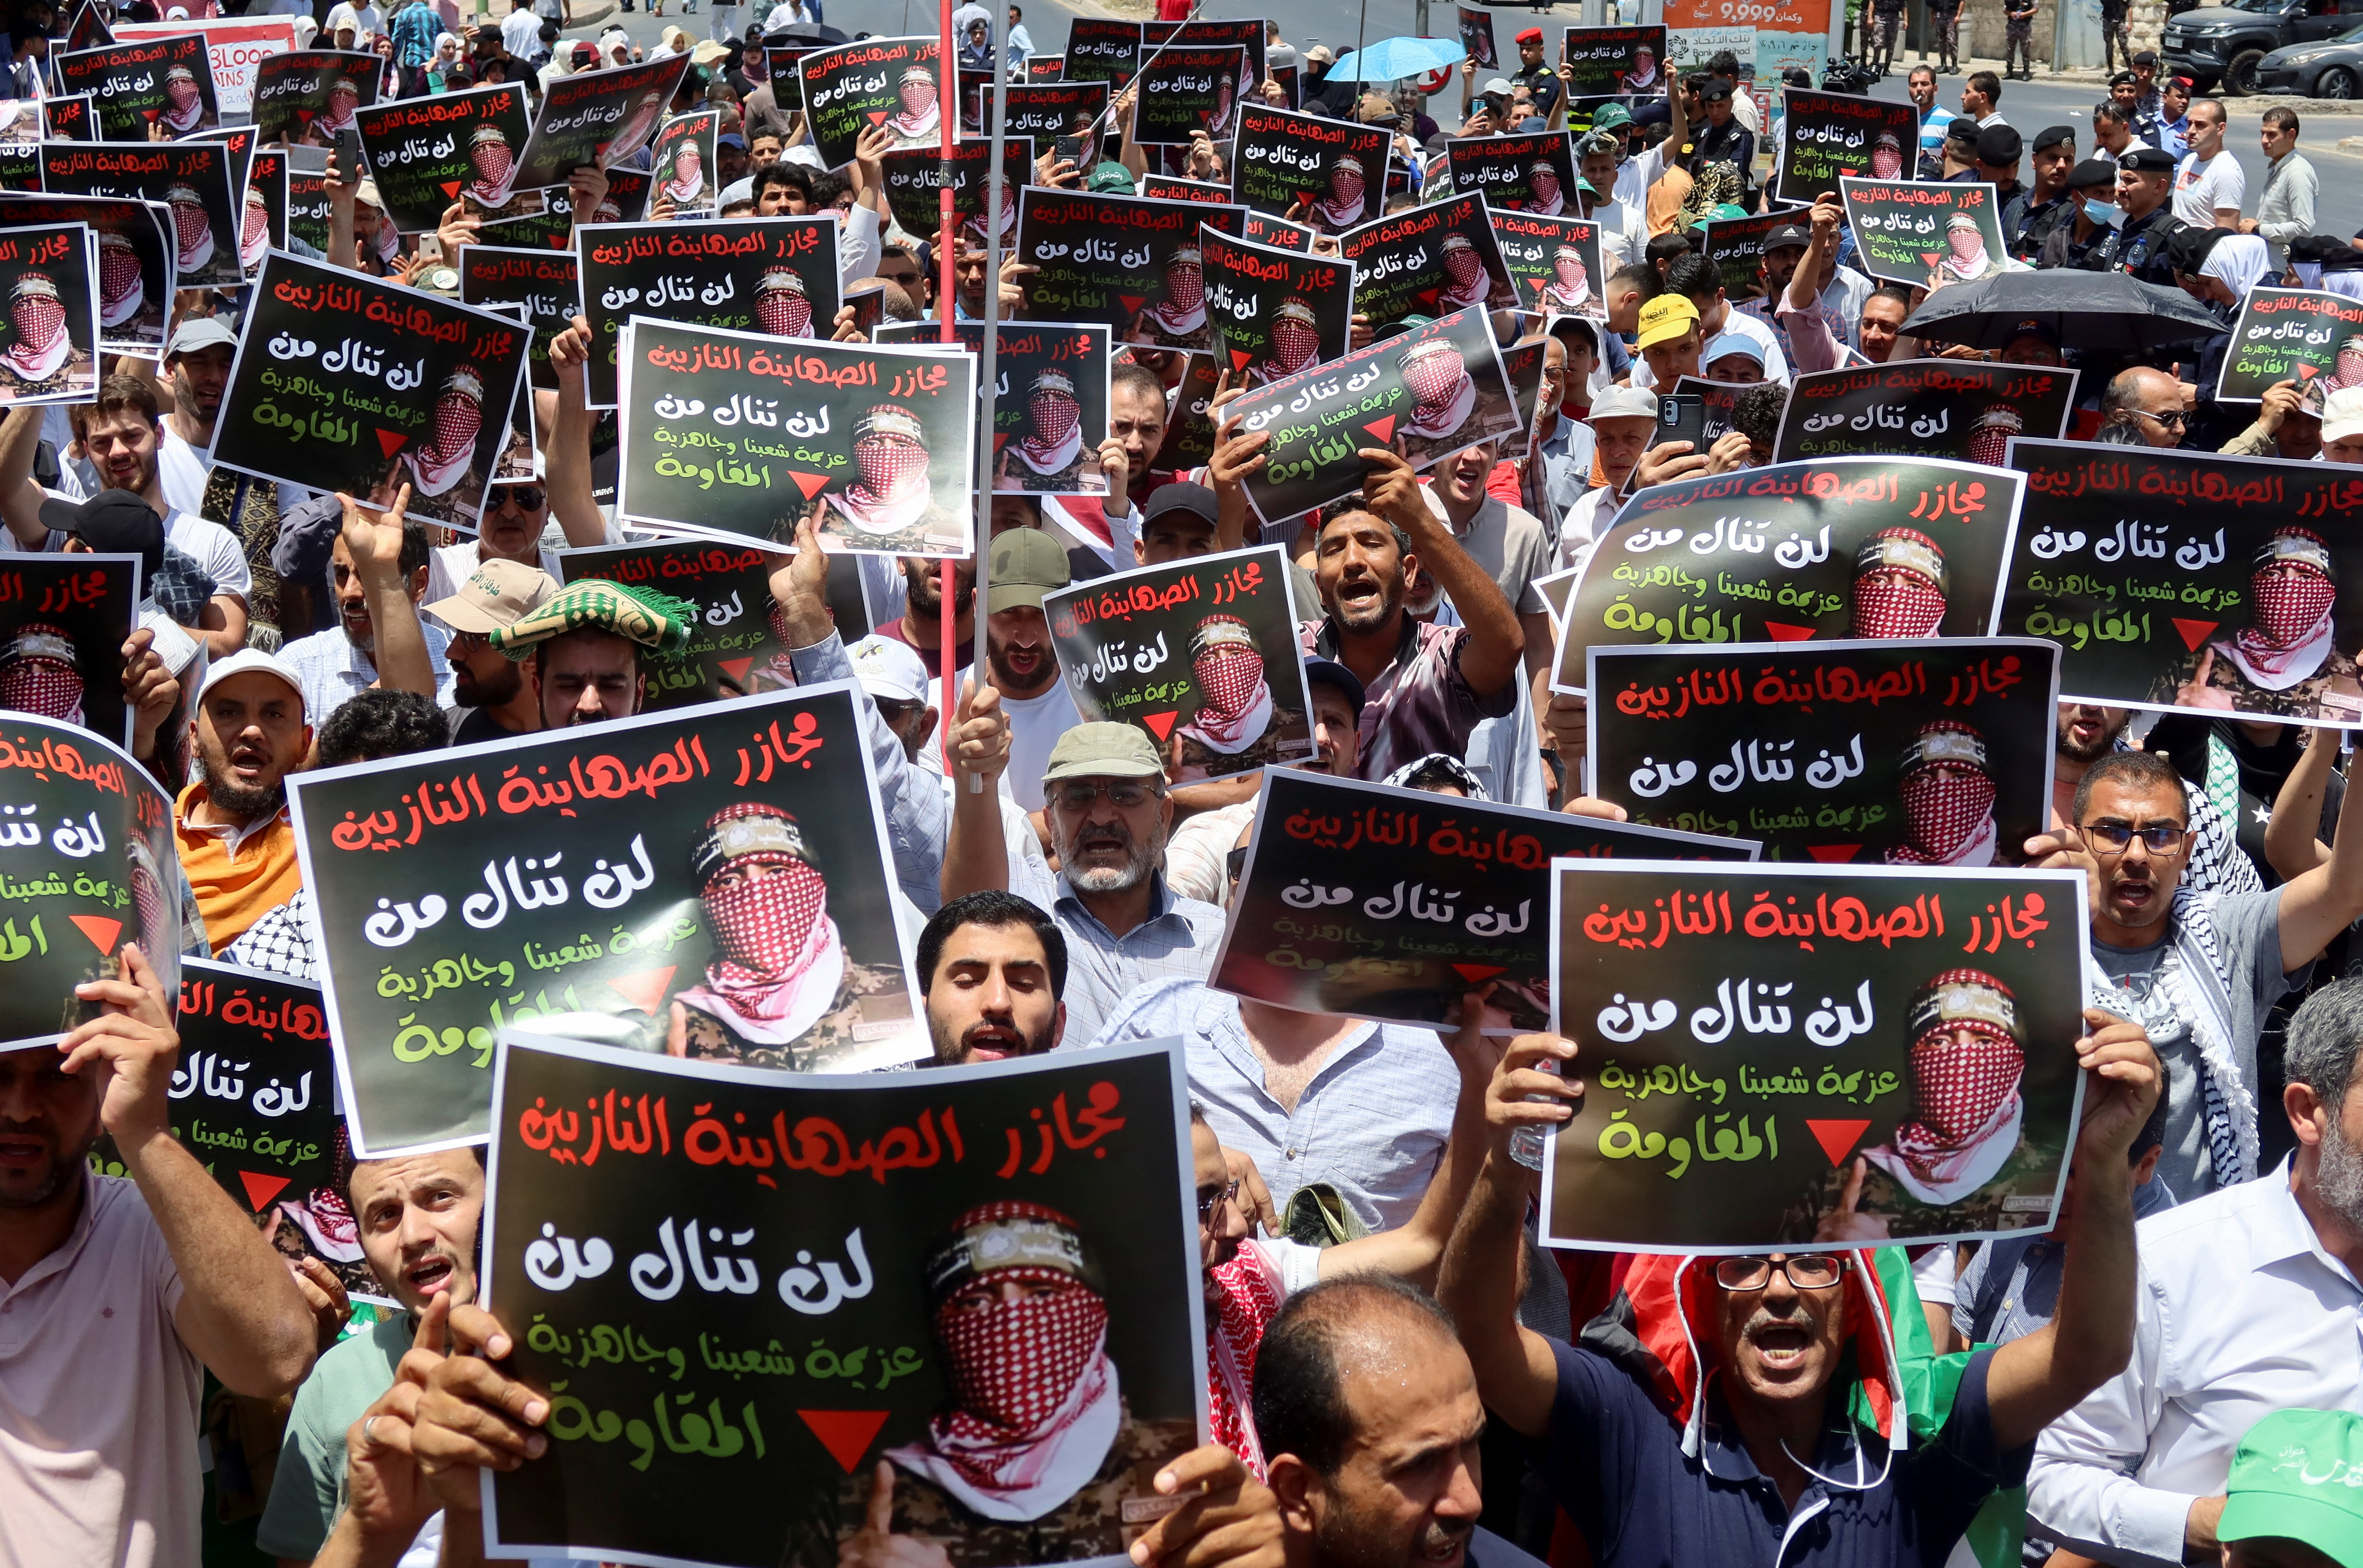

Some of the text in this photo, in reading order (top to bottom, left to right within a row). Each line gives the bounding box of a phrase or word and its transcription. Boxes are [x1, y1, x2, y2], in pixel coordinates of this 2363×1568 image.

[1720, 2, 1803, 24] وكمان 9,999
[1612, 46, 1625, 58] لن
[1693, 34, 1750, 45] بنك الاتحاد
[67, 40, 197, 75] مجازر الصهاينة النازيين
[209, 48, 274, 70] BLOO
[807, 55, 842, 79] النازيين
[846, 45, 907, 65] الصهاينة
[1573, 51, 1588, 60] من
[134, 71, 154, 92] لن
[865, 71, 887, 92] لن
[408, 101, 473, 126] الصهاينة
[482, 93, 512, 117] مجازر
[813, 90, 831, 107] من
[847, 97, 896, 112] عزيمة شعبنا
[823, 114, 860, 142] المقاومة
[1246, 116, 1378, 151] مجازر الصهاينة النازيين
[1796, 126, 1814, 140] من
[1845, 129, 1864, 147] لن
[378, 151, 397, 167] من
[433, 133, 455, 158] لن
[1245, 144, 1320, 171] لن تنال من
[1826, 149, 1868, 166] عزيمة شعبنا
[1793, 161, 1833, 182] المقاومة
[1245, 181, 1289, 202] المقاومة
[1850, 187, 1984, 208] مجازر الصهاينة النازيين
[1861, 212, 1936, 233] لن تنال من
[1871, 245, 1916, 264] المقاومة
[274, 280, 512, 361] مجازر الصهاينة النازيين
[2253, 297, 2363, 323] الصهاينة النازيين
[1421, 313, 1464, 338] مجازر
[2248, 321, 2332, 344] لن تنال من
[269, 331, 424, 390] لن تنال من
[647, 343, 948, 398] مجازر الصهاينة النازيين
[1310, 335, 1409, 377] الصهاينة
[2236, 357, 2289, 378] المقاومة
[1346, 362, 1380, 391] لن
[253, 398, 358, 445] المقاومة
[654, 394, 705, 419] من
[713, 394, 778, 426] تنال
[786, 404, 829, 437] لن
[1246, 405, 1283, 430] من
[1320, 404, 1358, 426] شعبنا
[654, 427, 848, 469] عزيمة شعبنا وجاهزية
[1267, 431, 1357, 484] المقاومة
[655, 453, 771, 489] المقاومة
[2029, 461, 2130, 497] النازيين
[2138, 470, 2283, 507] الصهاينة
[2030, 519, 2225, 570] لن تنال من
[1100, 574, 1200, 621] الصهاينة
[1212, 562, 1263, 604] مجازر
[2026, 609, 2150, 650] المقاومة
[1133, 630, 1168, 673] لن
[1071, 662, 1089, 690] من
[1616, 656, 2022, 720] مجازر الصهاينة النازيين
[1630, 733, 1863, 797] لن تنال من
[331, 712, 824, 852] مجازر الصهاينة النازيين
[365, 834, 654, 947] لن تنال من
[1583, 890, 2049, 953] مجازر الصهاينة النازيين
[523, 934, 602, 972] شعبنا
[377, 954, 515, 1001] وجاهزية
[1597, 978, 1873, 1046] لن تنال من
[1600, 1064, 1899, 1104] عزيمة شعبنا وجاهزية
[519, 1081, 1126, 1188] مجازر الصهاينة النازيين
[1598, 1109, 1778, 1179] المقاومة
[525, 1223, 613, 1291] من
[630, 1217, 759, 1300] تنال
[778, 1228, 873, 1314] لن
[527, 1313, 923, 1389] عزيمة شعبنا وجاهزية
[548, 1380, 766, 1471] المقاومة
[2279, 1445, 2306, 1457] عنوان
[2300, 1458, 2363, 1488] قدس
